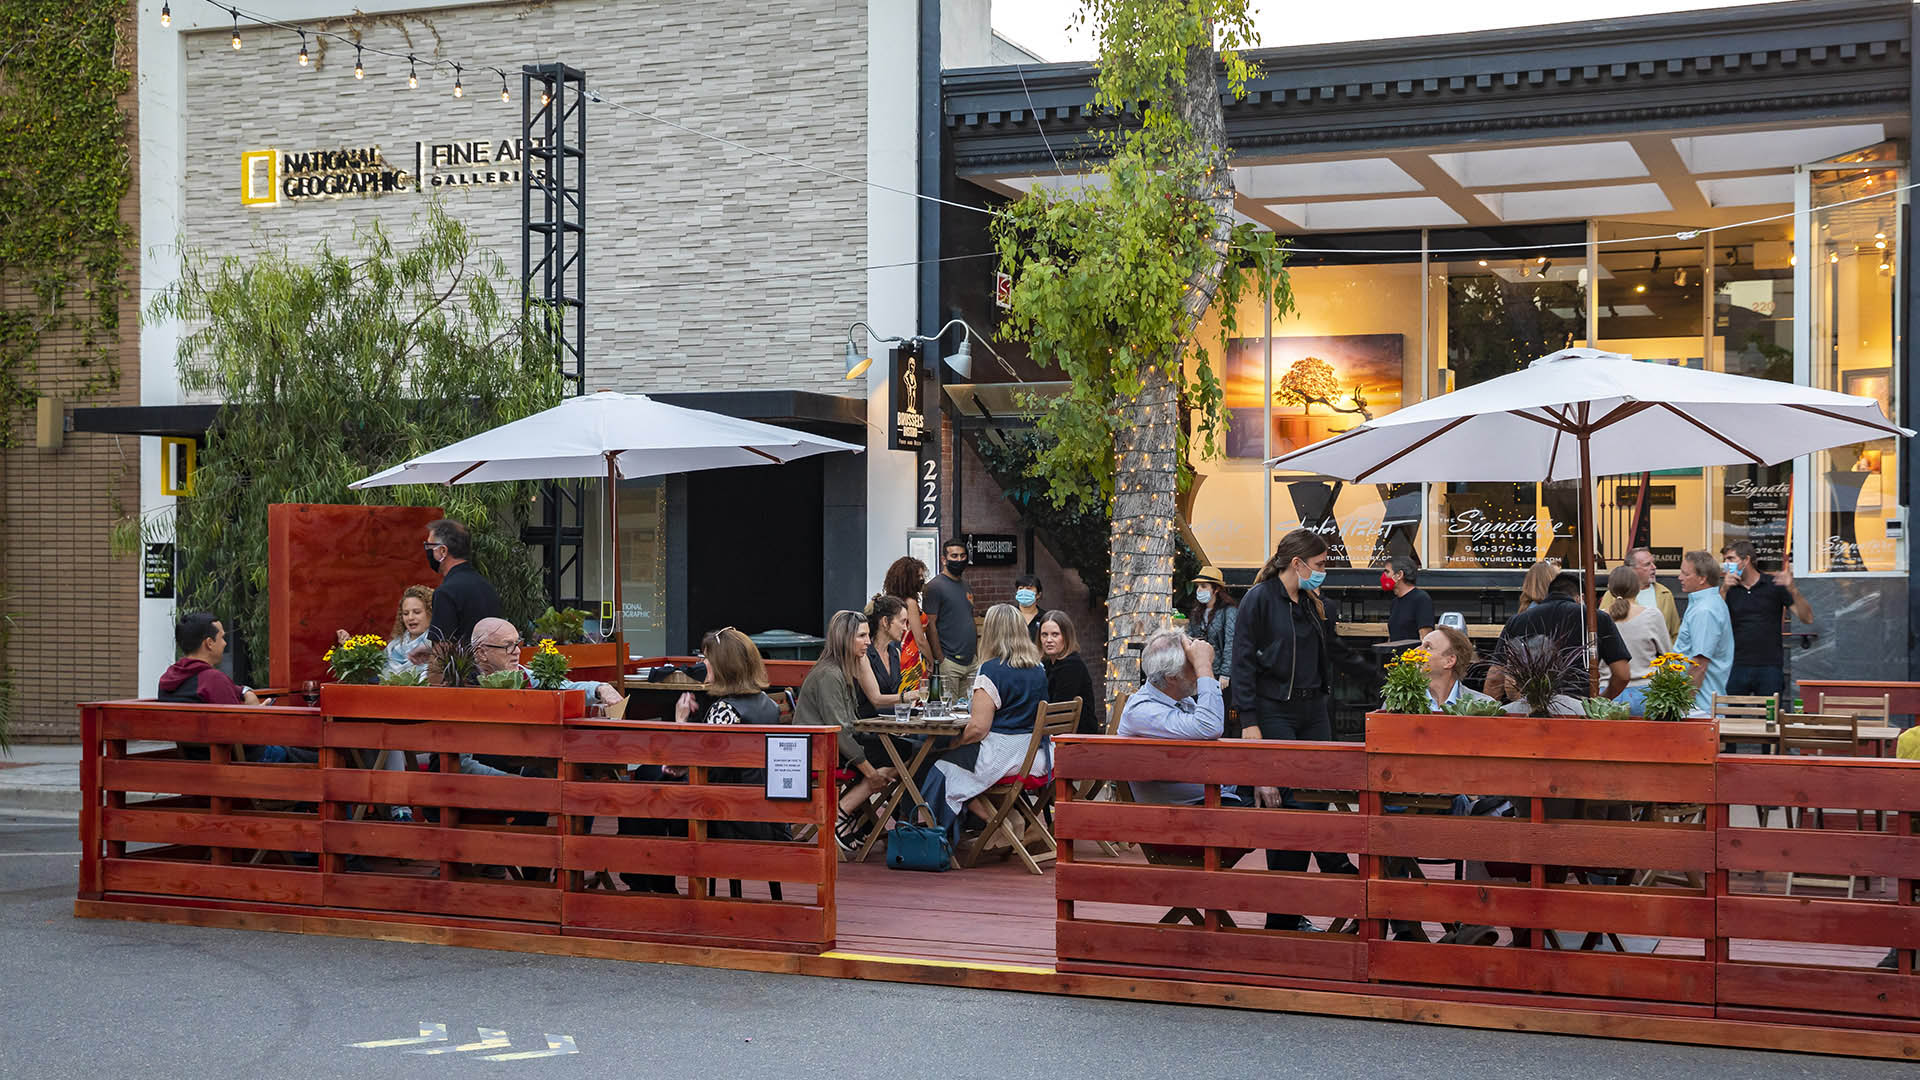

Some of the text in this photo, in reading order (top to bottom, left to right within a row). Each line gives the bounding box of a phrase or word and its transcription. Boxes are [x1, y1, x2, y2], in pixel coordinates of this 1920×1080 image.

[283, 148, 381, 173] NATIONAL
[431, 141, 490, 167] FINE
[282, 169, 408, 197] GEOGRAPHIC
[430, 168, 546, 187] GALLERIS
[897, 411, 925, 429] BRUSSELS
[923, 460, 938, 524] 222
[1731, 478, 1790, 499] Signatu
[1448, 508, 1563, 541] Signature
[977, 540, 998, 553] BRUSSELS
[1464, 545, 1547, 553] 949-376-4244
